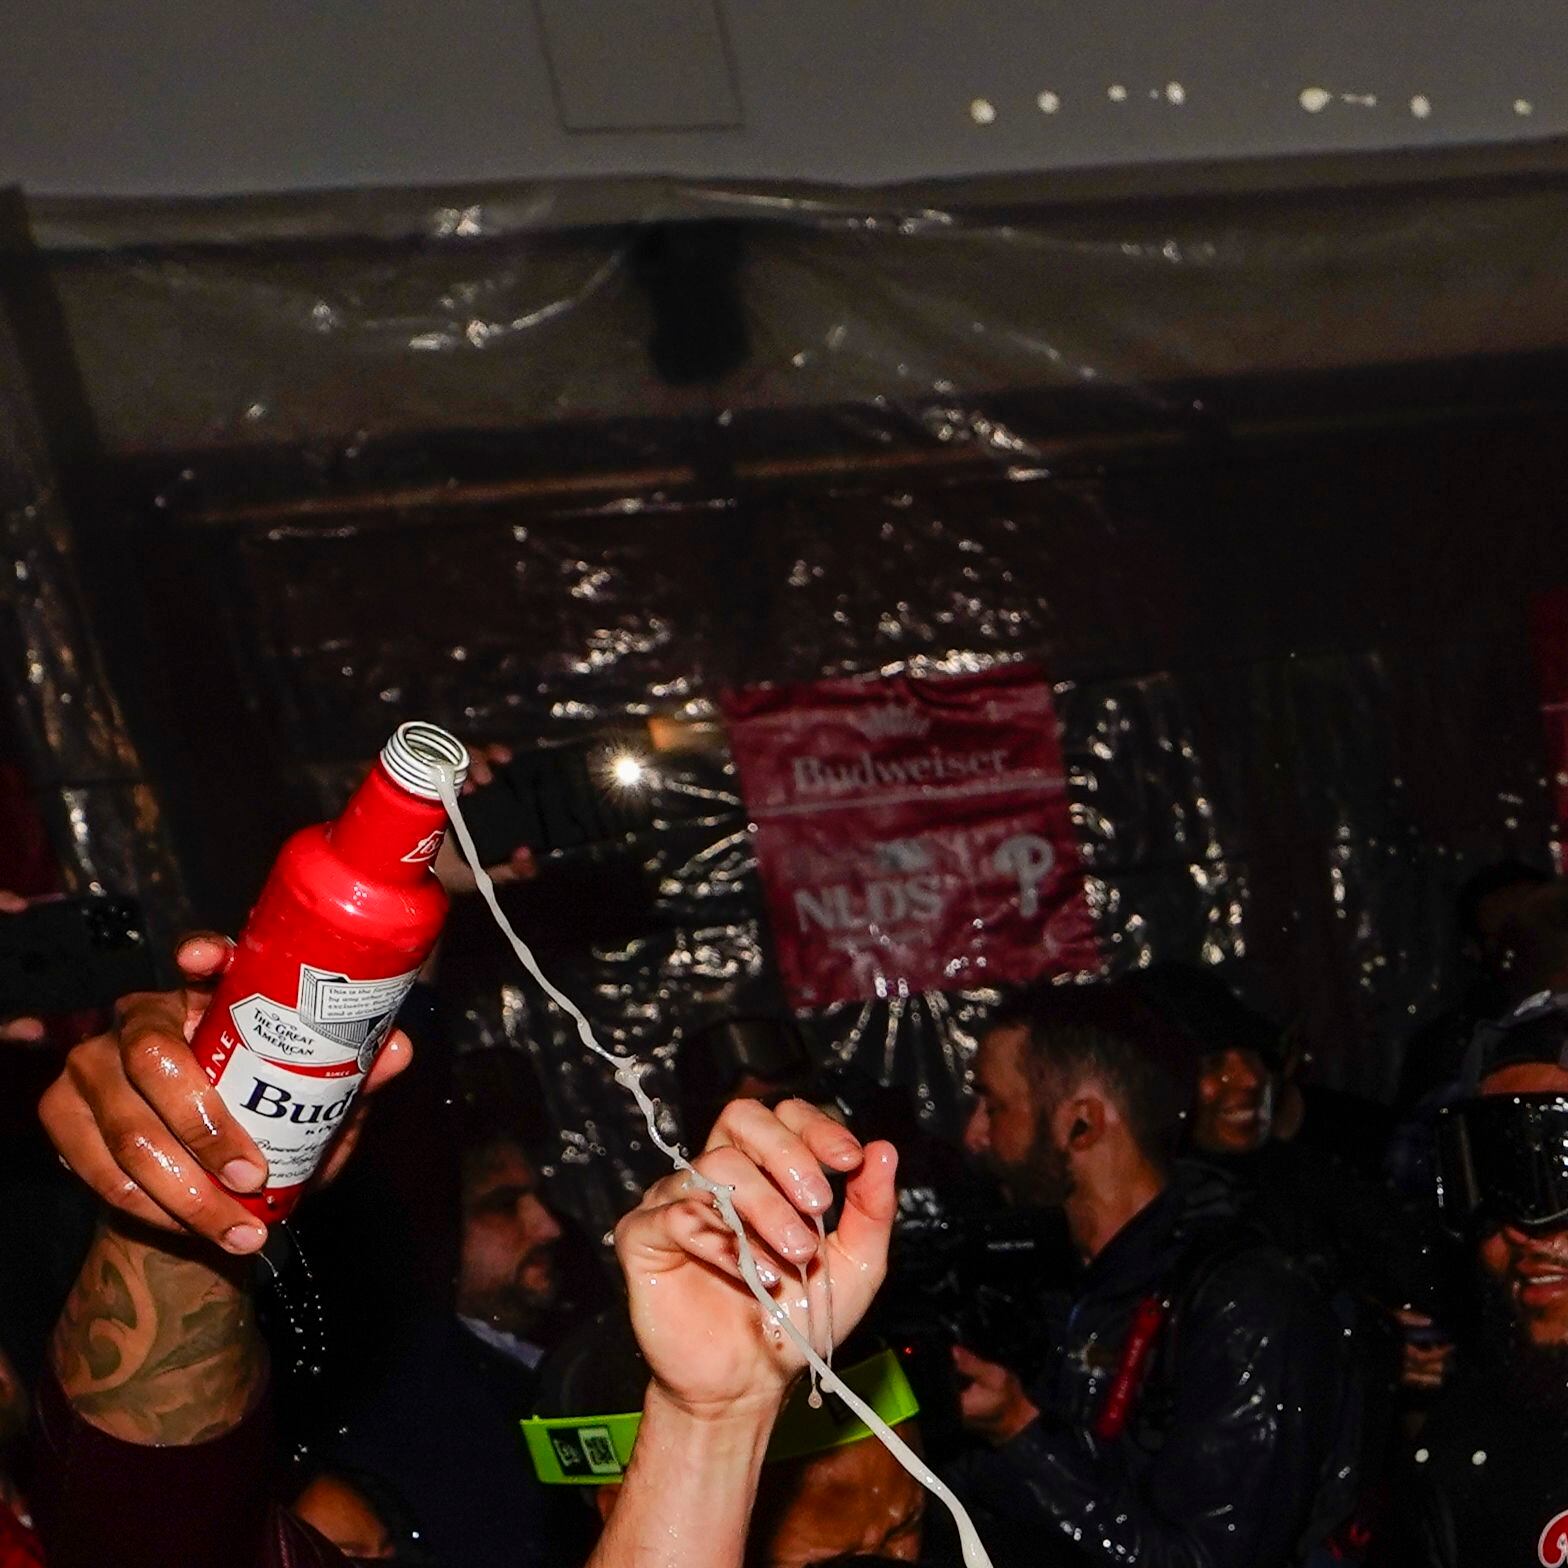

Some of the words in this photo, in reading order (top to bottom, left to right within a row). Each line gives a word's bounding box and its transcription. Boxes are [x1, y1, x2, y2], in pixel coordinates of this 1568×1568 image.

[792, 747, 1008, 792] Budweiser
[793, 875, 946, 932] NLDS
[252, 1024, 315, 1056] AMERICAN
[253, 1007, 273, 1029] THE
[274, 1022, 317, 1046] GREAT
[205, 1030, 235, 1084] INE
